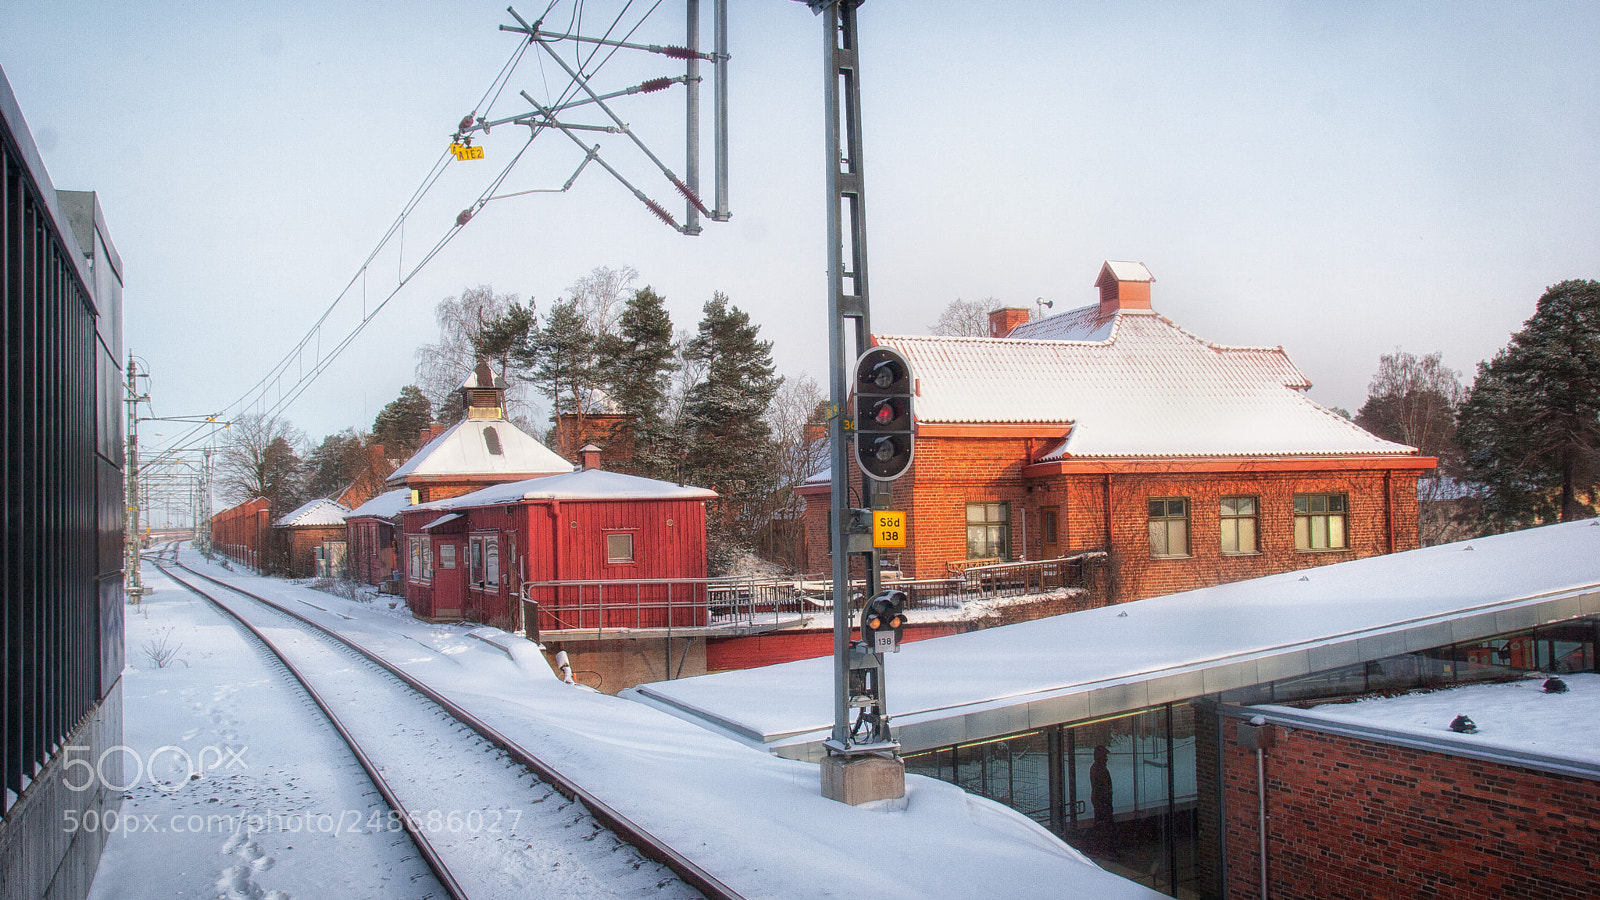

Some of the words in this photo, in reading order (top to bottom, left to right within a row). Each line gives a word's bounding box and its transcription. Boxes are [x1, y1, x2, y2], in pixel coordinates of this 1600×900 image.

[459, 149, 482, 160] A1E2
[880, 517, 900, 527] Söd
[881, 531, 899, 541] 138
[878, 637, 892, 646] 138
